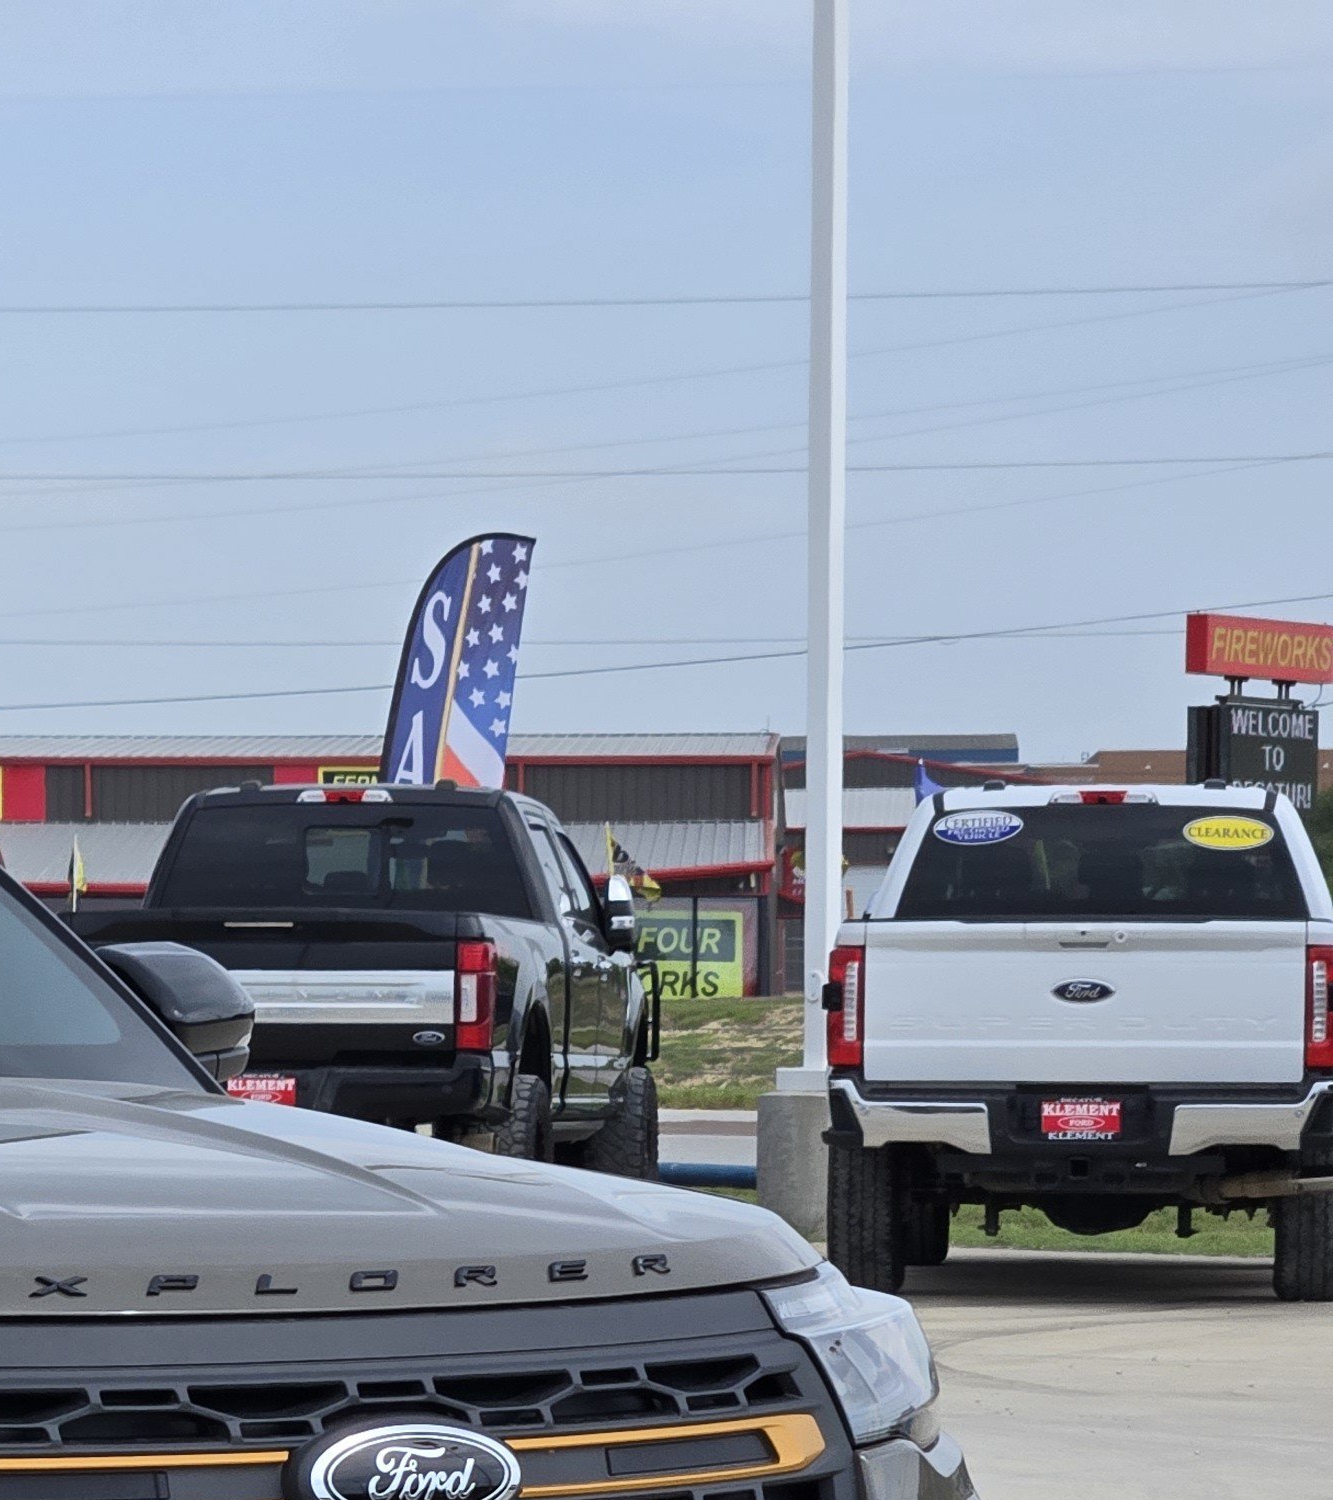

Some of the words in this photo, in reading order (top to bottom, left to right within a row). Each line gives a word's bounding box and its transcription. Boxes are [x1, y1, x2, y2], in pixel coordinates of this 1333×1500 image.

[1212, 626, 1333, 671] FIREWORKS
[1231, 708, 1314, 740] WELCOME
[1262, 746, 1284, 771] TO
[1188, 825, 1269, 839] CLEARANCE
[637, 926, 722, 954] FOUR
[1065, 983, 1101, 999] Ford
[227, 1079, 296, 1091] KLEMENT
[1042, 1103, 1121, 1116] KLEMENT
[1048, 1132, 1114, 1140] KLEMENT
